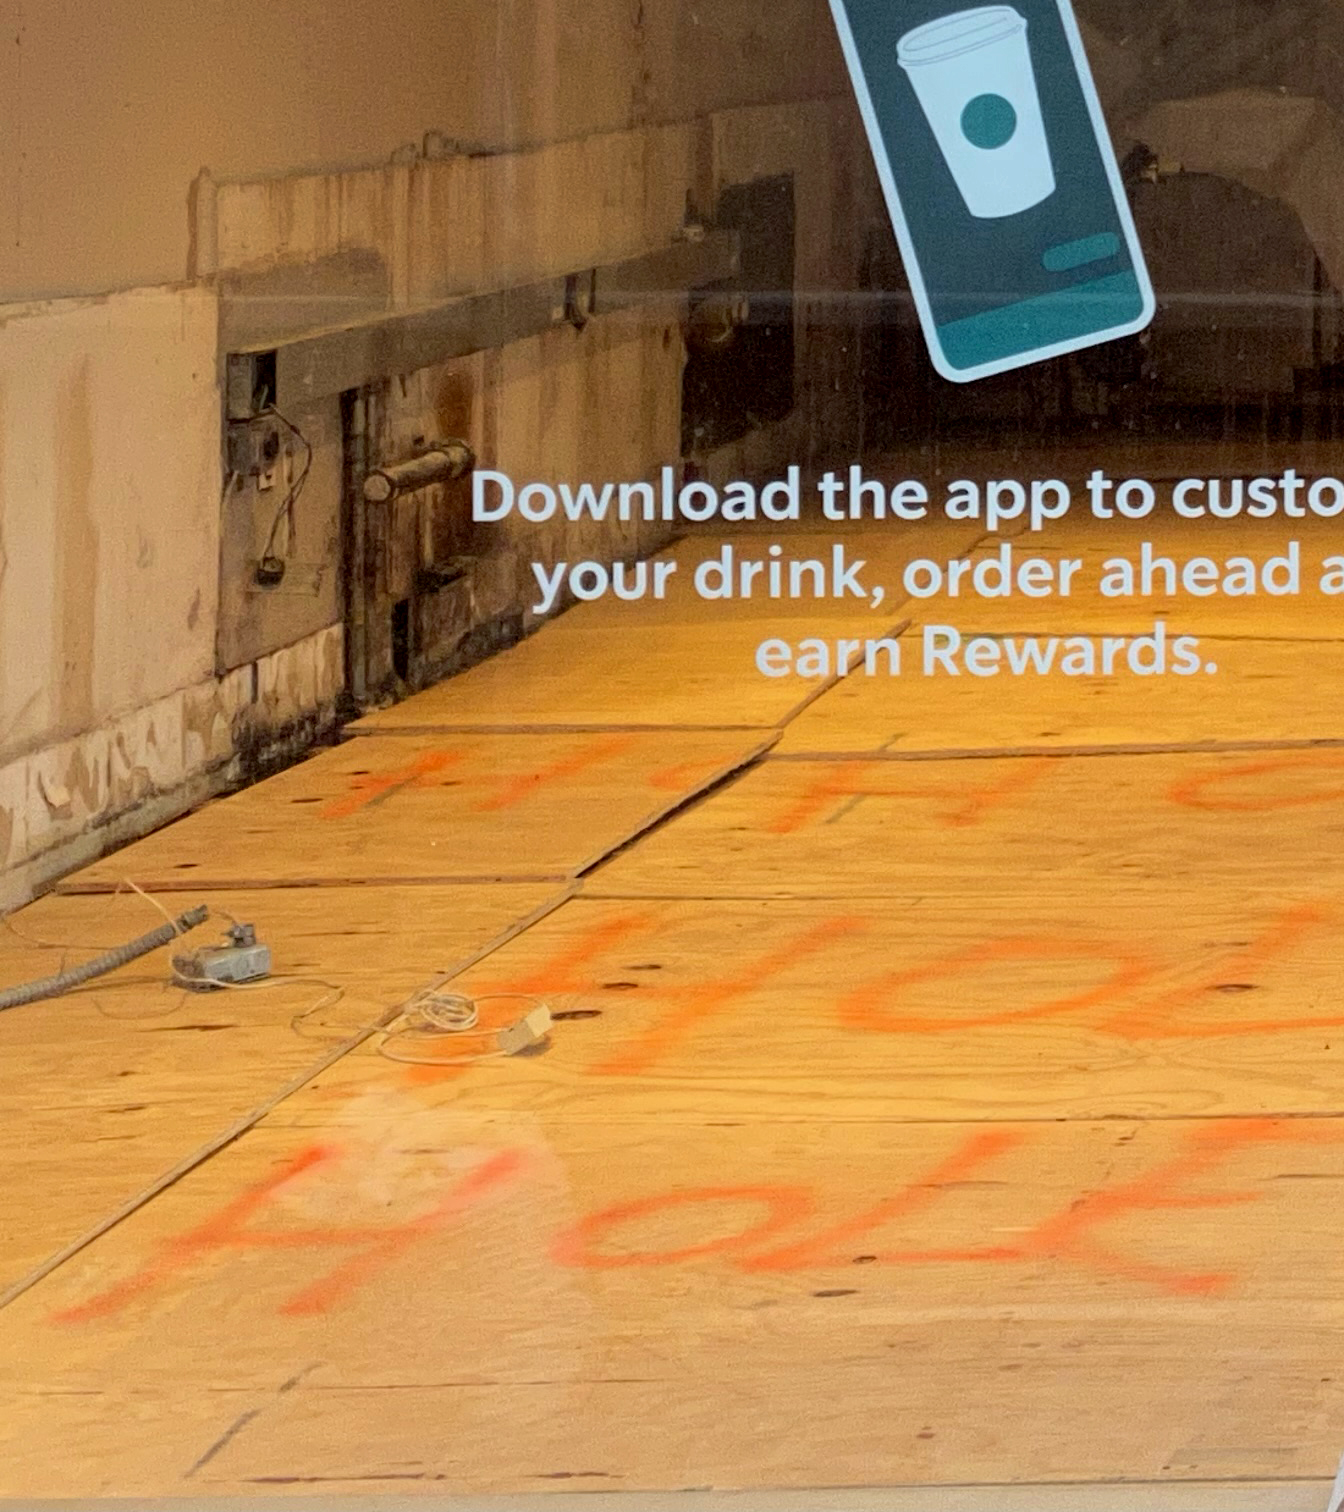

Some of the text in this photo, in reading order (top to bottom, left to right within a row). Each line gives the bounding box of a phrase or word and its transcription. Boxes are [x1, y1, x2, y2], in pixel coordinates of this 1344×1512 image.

[472, 465, 800, 522] Download
[817, 465, 928, 520] the
[945, 479, 1070, 531] app
[1086, 470, 1155, 519] to
[531, 561, 677, 614] your
[694, 544, 885, 607] drink,
[903, 542, 1082, 598] order
[1099, 541, 1300, 597] ahead
[755, 620, 1217, 677] earn Rewards.
